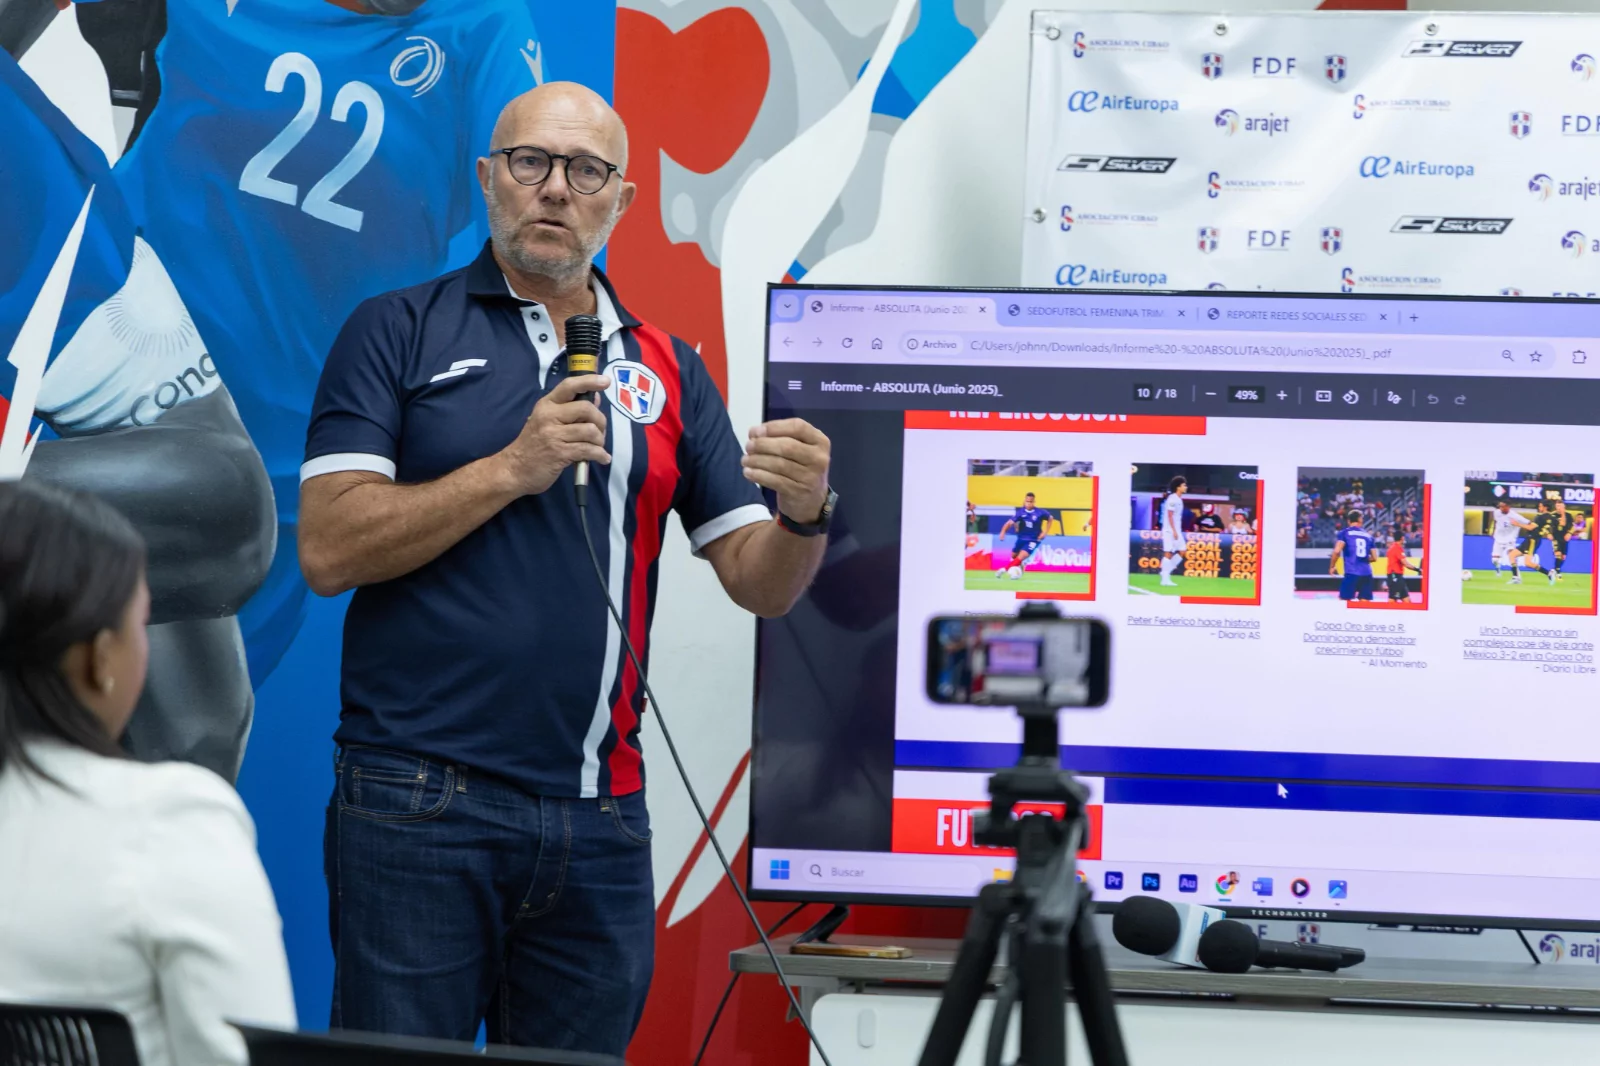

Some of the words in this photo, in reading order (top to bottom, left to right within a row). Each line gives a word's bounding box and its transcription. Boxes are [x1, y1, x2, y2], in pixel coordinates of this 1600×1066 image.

[1449, 43, 1514, 55] SILVER
[1252, 57, 1297, 75] FDF
[1101, 96, 1179, 114] AirEuropa
[1245, 113, 1290, 136] arajet
[239, 52, 385, 232] 22
[1105, 158, 1169, 171] SILVER
[1393, 161, 1475, 179] AirEuropa
[1558, 176, 1600, 201] araje
[1440, 220, 1505, 232] SILVER
[1248, 230, 1291, 247] FDF
[1089, 269, 1168, 287] AirEuropa
[874, 304, 921, 314] ABSOLUTA
[1027, 306, 1088, 317] SEDOFUTBOL
[1227, 310, 1267, 320] REPORTE
[1270, 311, 1299, 321] REDES
[1302, 312, 1347, 322] SOCIALES
[922, 338, 957, 350] Archivo
[821, 381, 863, 393] Informe
[873, 382, 930, 395] ABSOLUTA
[933, 383, 965, 396] (Junio
[1137, 388, 1150, 398] 10
[1164, 388, 1177, 399] 18
[1235, 390, 1258, 400] 49%
[1508, 486, 1543, 499] MEX
[1185, 541, 1222, 552] GOAL
[1355, 537, 1367, 557] 8
[1184, 550, 1224, 562] GOAL
[1184, 560, 1221, 571] GOAL
[1128, 615, 1152, 625] Peter
[1154, 616, 1196, 626] Federico
[1198, 617, 1222, 628] hace
[1224, 618, 1261, 629] historia
[1314, 621, 1342, 632] Copa
[1344, 622, 1363, 632] Oro
[1364, 622, 1387, 632] sirve
[1218, 630, 1247, 640] Diario
[1248, 631, 1261, 640] AS
[1480, 626, 1500, 636] Una
[1501, 626, 1563, 638] Dominicana
[1564, 627, 1579, 637] sin
[1303, 632, 1363, 644] Dominicana
[1365, 634, 1417, 646] demostrar
[1315, 645, 1374, 656] crecimiento
[1538, 640, 1552, 649] de
[1571, 641, 1594, 651] ante
[1575, 653, 1594, 662] Oro
[1369, 659, 1378, 668] Al
[1380, 659, 1428, 669] Momento
[1543, 664, 1572, 674] Diario
[1573, 664, 1597, 674] Libre
[831, 866, 865, 878] Buscar
[1107, 875, 1121, 887] Pr
[1143, 876, 1158, 888] Ps
[1180, 878, 1197, 889] Au
